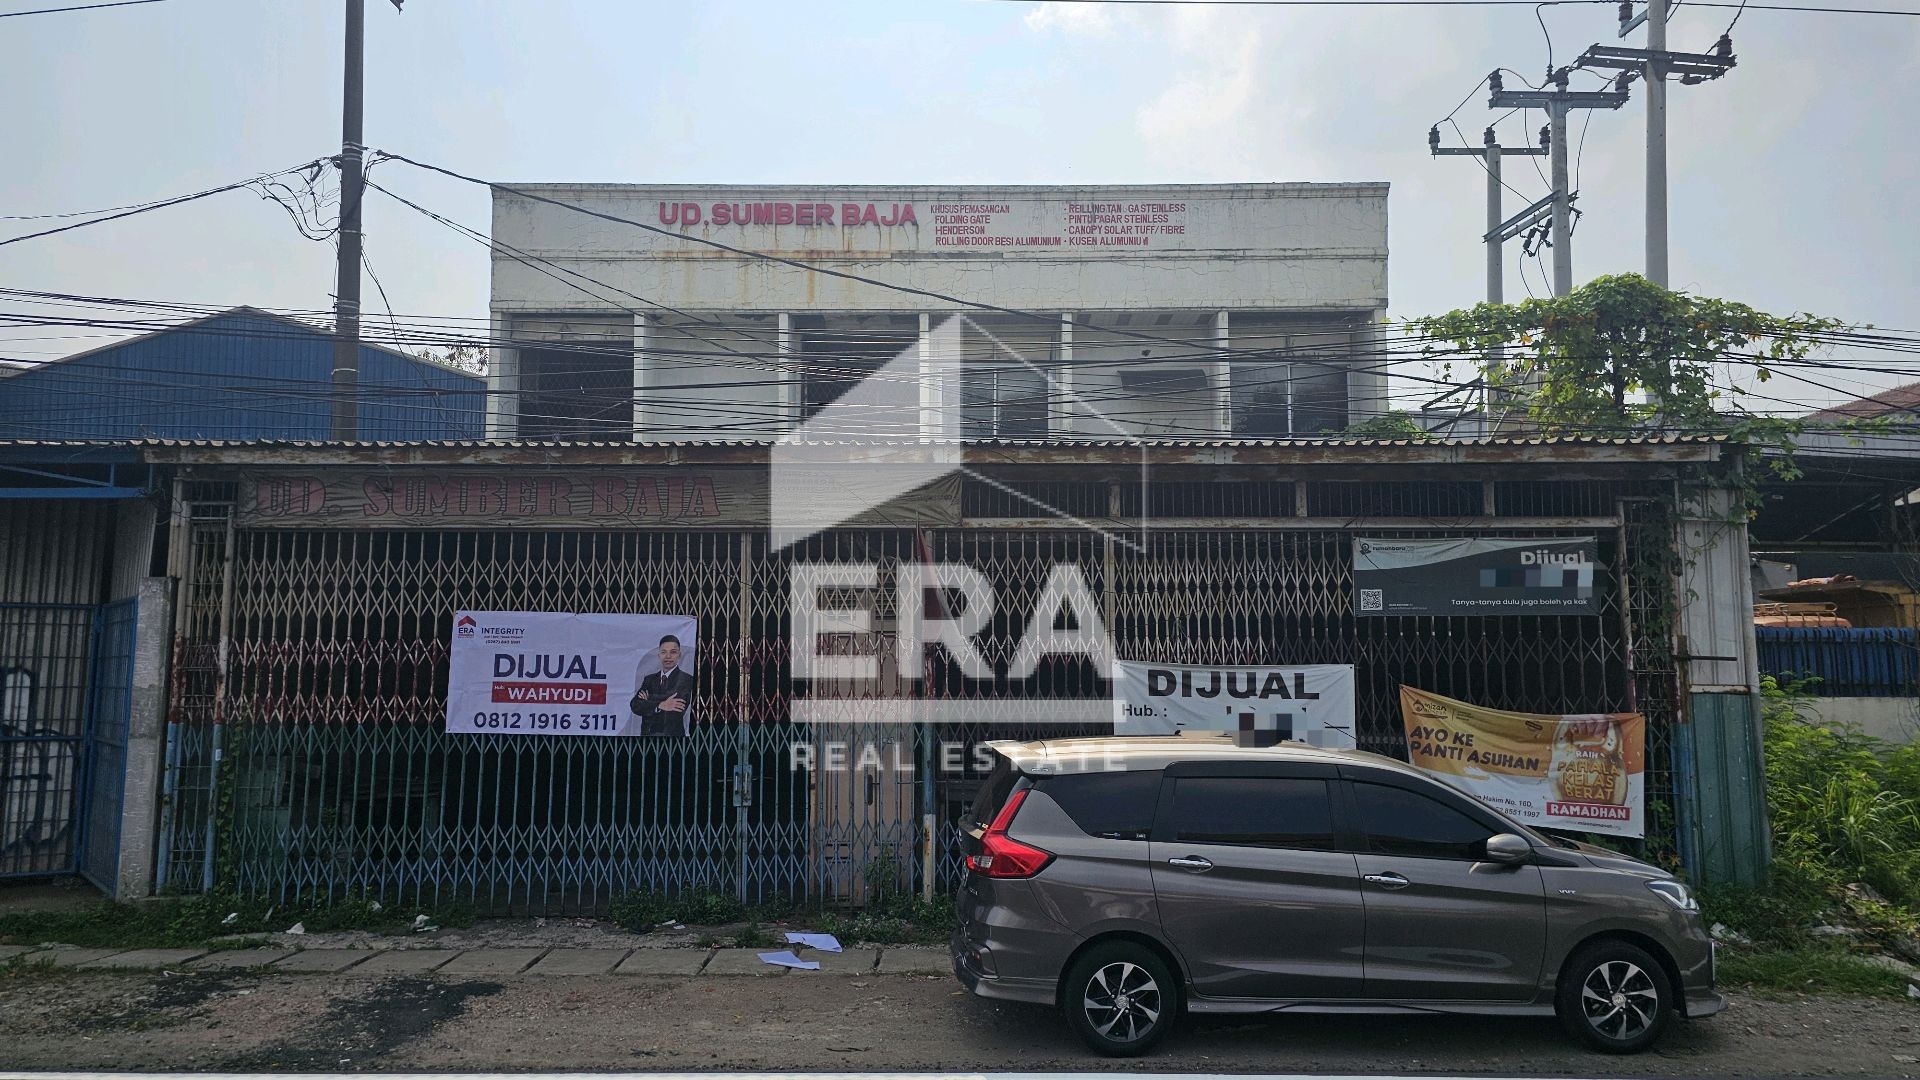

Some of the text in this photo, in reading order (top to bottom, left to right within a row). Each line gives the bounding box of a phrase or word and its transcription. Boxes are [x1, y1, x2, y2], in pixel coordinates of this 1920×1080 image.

[930, 204, 1010, 214] KHUSUS PEMASANGAN
[1140, 203, 1186, 213] STEINLESS
[841, 202, 918, 226] BAJA
[935, 214, 991, 224] FOLDING GATE
[1124, 214, 1169, 223] STEINLESS
[935, 225, 985, 235] HENDERSON
[1068, 225, 1103, 235] CANOPY
[1104, 225, 1133, 235] SOLAR
[935, 236, 1061, 246] ROLLING DOOR BESI ALUMUNIUM
[1069, 236, 1098, 246] KUSEN
[362, 476, 574, 517] SUMBER
[590, 476, 721, 520] BAJA
[1451, 599, 1501, 607] Tanya-tanya
[1521, 599, 1538, 607] juga
[458, 627, 525, 635] ERA INTEGRITY
[493, 653, 607, 680] DIJUAL
[1147, 669, 1320, 700] DIJUAL
[508, 686, 592, 702] WAHYUDI
[473, 711, 618, 731] 0812 1916 3111
[1409, 725, 1449, 743] AYO
[1452, 732, 1475, 748] KE
[1410, 740, 1464, 761] PANTI
[1467, 751, 1540, 771] ASUHAN
[1575, 750, 1599, 759] RAIH
[1557, 760, 1621, 776] PAHALA
[1562, 772, 1615, 788] KELAS
[1565, 784, 1614, 800] BERAT
[1482, 795, 1504, 803] Hakim
[1504, 798, 1517, 806] No.
[1504, 808, 1521, 816] 8551
[1523, 810, 1541, 818] 1997
[1550, 803, 1627, 819] RAMADHAN
